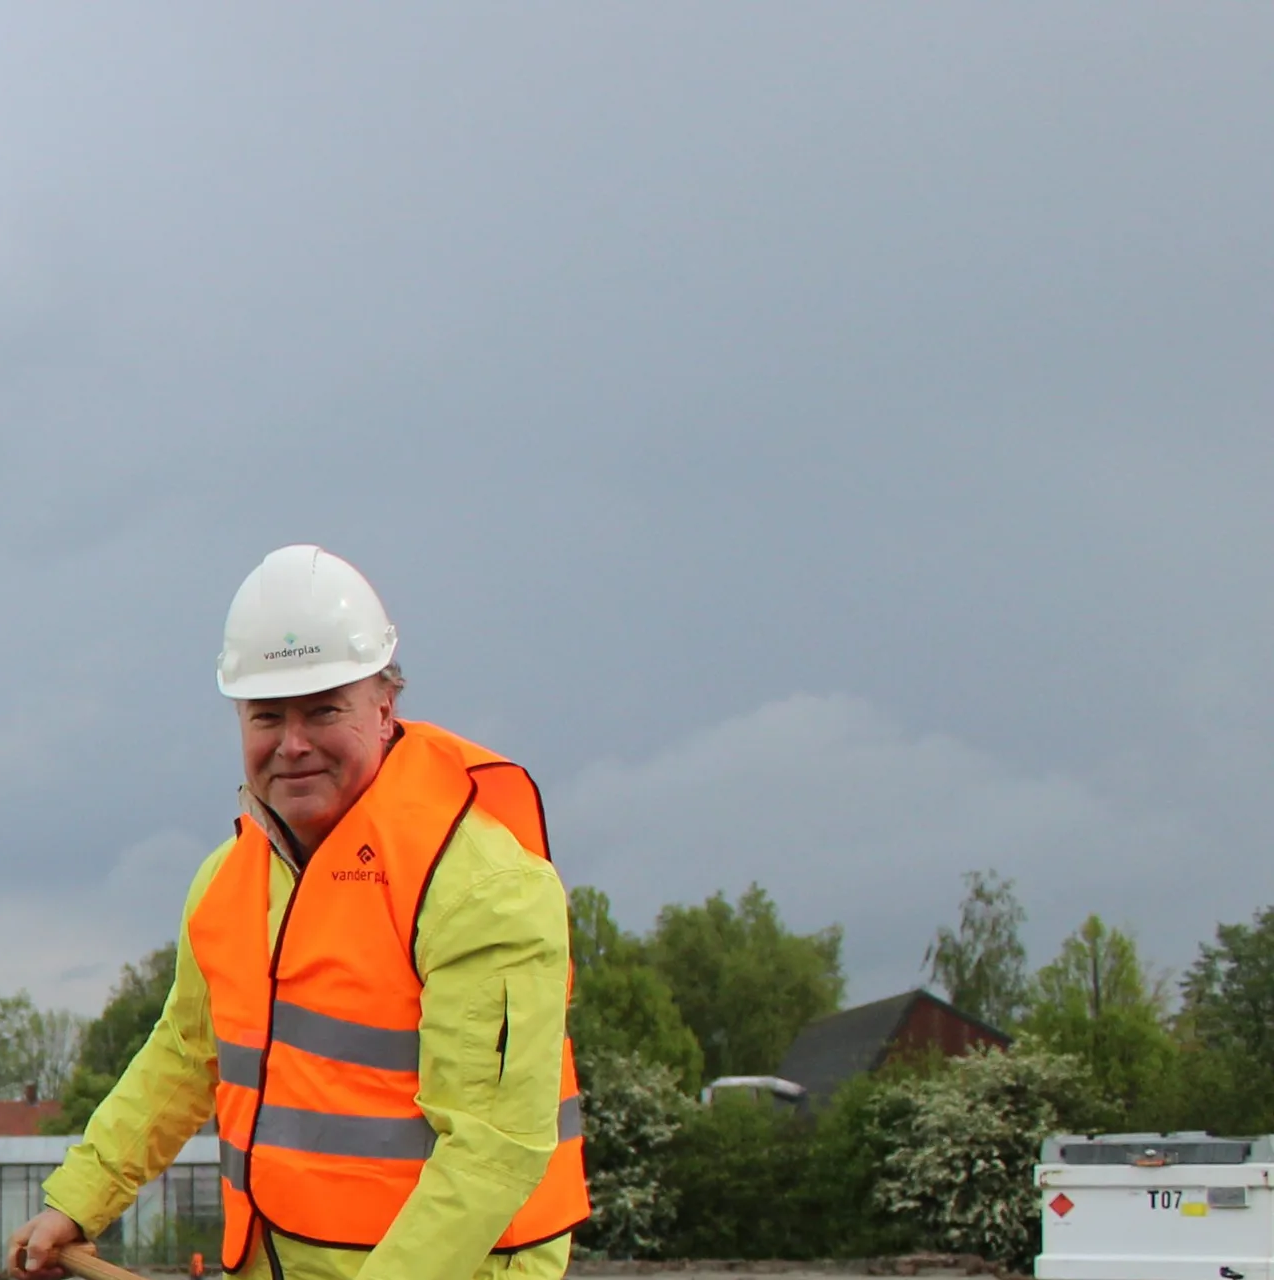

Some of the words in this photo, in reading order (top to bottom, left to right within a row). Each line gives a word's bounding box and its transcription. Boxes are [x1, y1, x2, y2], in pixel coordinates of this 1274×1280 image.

[263, 644, 321, 660] vanderplas
[331, 868, 389, 886] vanderpl
[1148, 1190, 1184, 1210] T07
